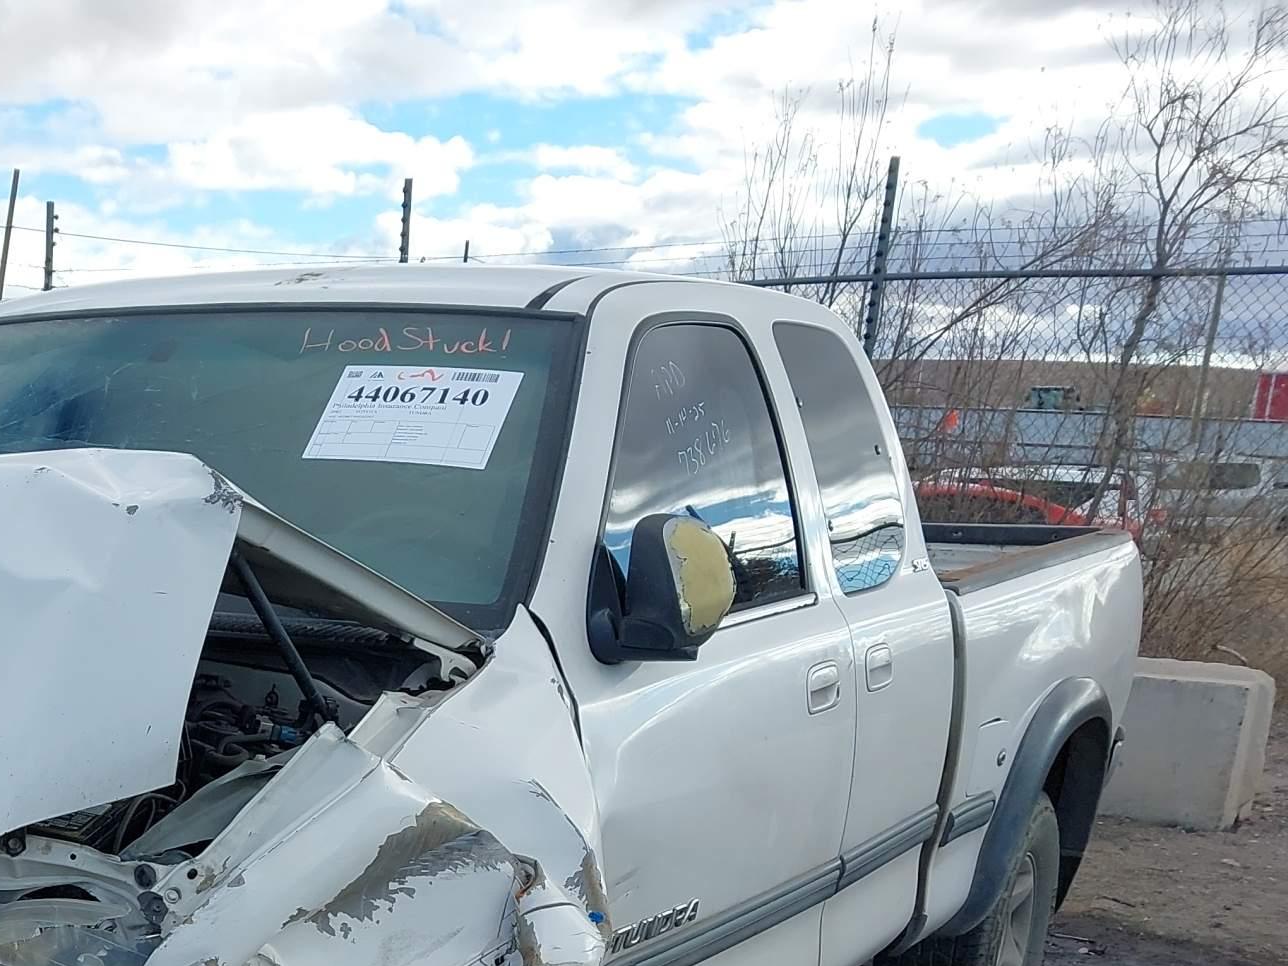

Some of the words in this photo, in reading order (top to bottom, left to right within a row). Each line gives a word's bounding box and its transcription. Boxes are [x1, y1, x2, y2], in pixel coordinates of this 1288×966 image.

[300, 327, 392, 354] Hood
[397, 327, 512, 359] Stuck!
[346, 385, 490, 407] 44067140
[611, 898, 700, 954] TUNDRA
